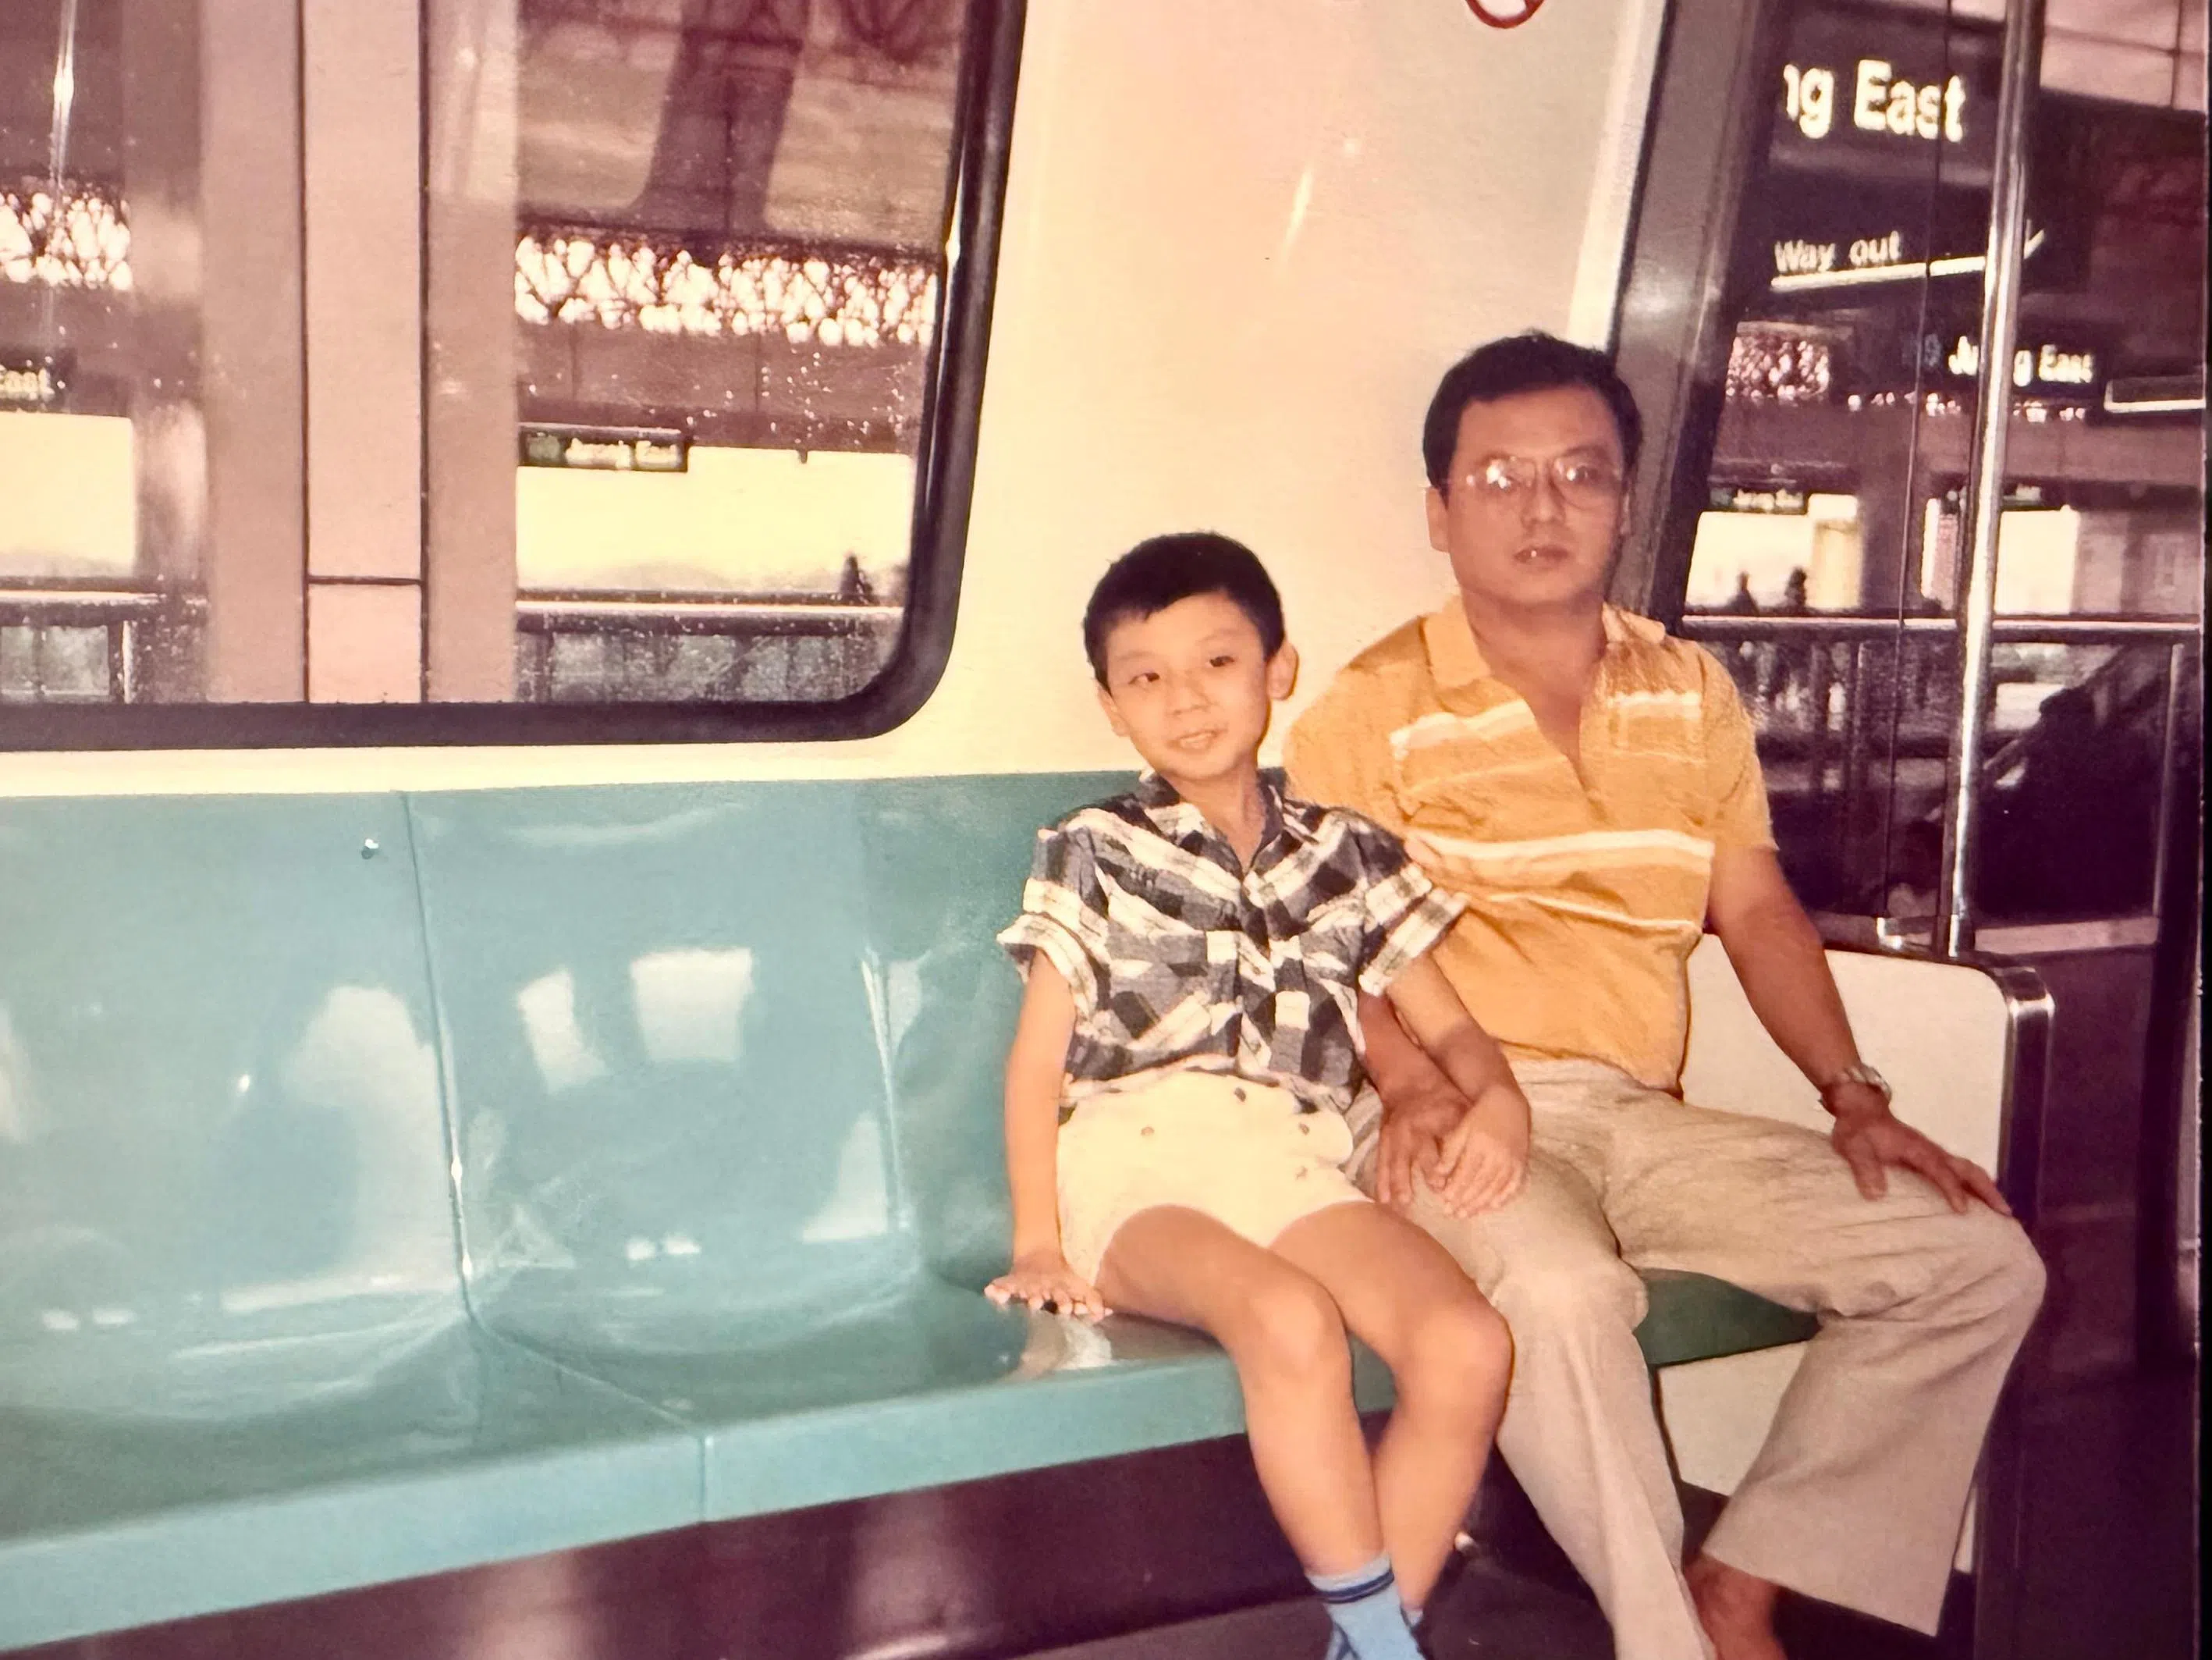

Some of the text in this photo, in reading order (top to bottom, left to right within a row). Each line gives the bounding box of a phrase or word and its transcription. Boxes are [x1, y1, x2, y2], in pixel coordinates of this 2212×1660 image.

[1854, 59, 1965, 142] East
[1774, 230, 1901, 273] Way out
[2039, 344, 2094, 383] East
